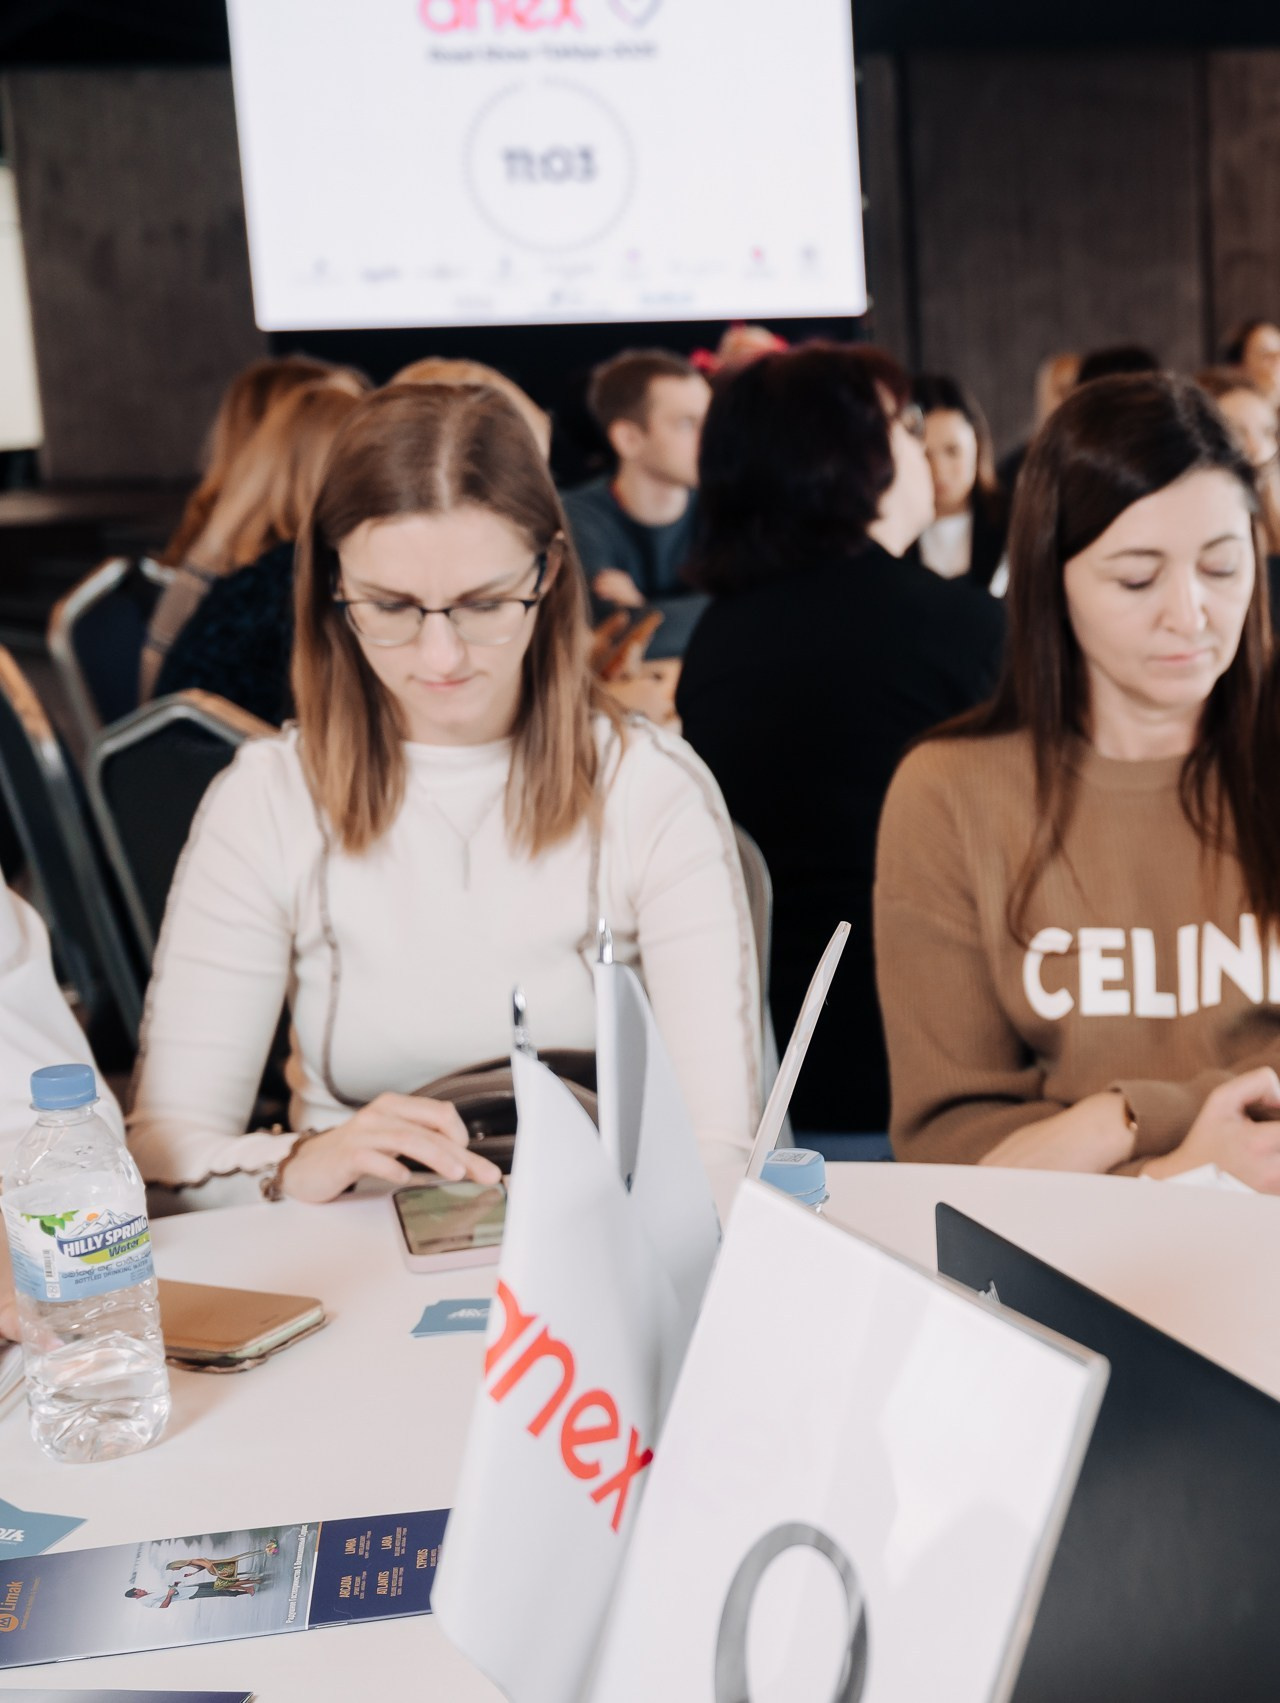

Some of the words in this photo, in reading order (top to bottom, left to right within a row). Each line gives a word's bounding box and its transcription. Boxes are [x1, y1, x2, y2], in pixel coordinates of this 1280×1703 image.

[62, 1233, 104, 1258] HILLY
[108, 1238, 140, 1258] Water
[0, 1580, 24, 1611] Limak
